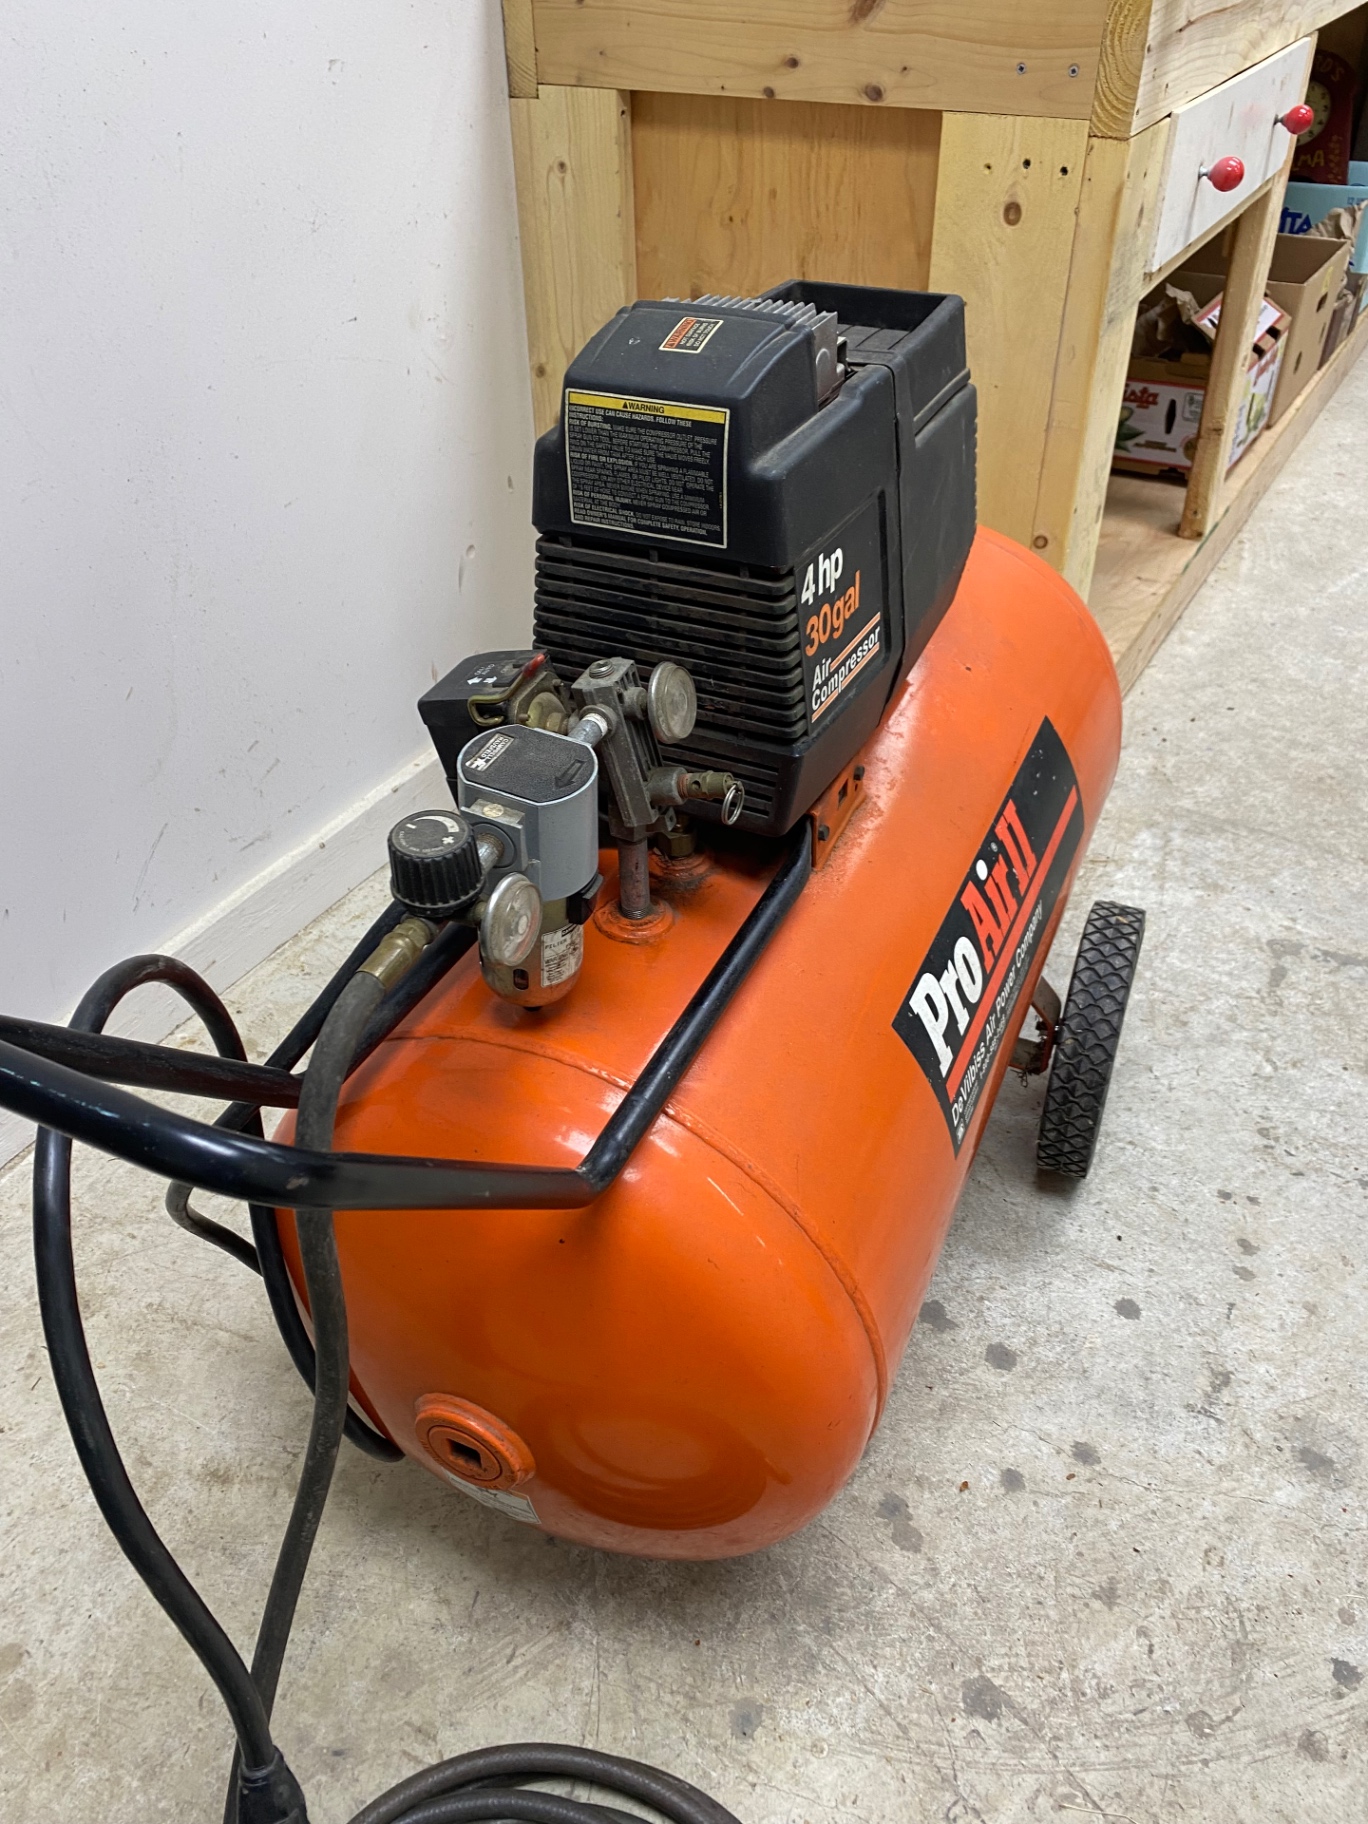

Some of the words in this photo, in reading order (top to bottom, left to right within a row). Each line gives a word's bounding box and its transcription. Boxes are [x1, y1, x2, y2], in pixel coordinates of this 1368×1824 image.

[628, 402, 664, 413] WARNING
[811, 626, 881, 711] Compressor
[812, 657, 832, 691] Air
[952, 1041, 986, 1127] DeVilbiss
[985, 1013, 996, 1047] Air
[995, 971, 1016, 1018] Power
[1015, 899, 1044, 969] Company
